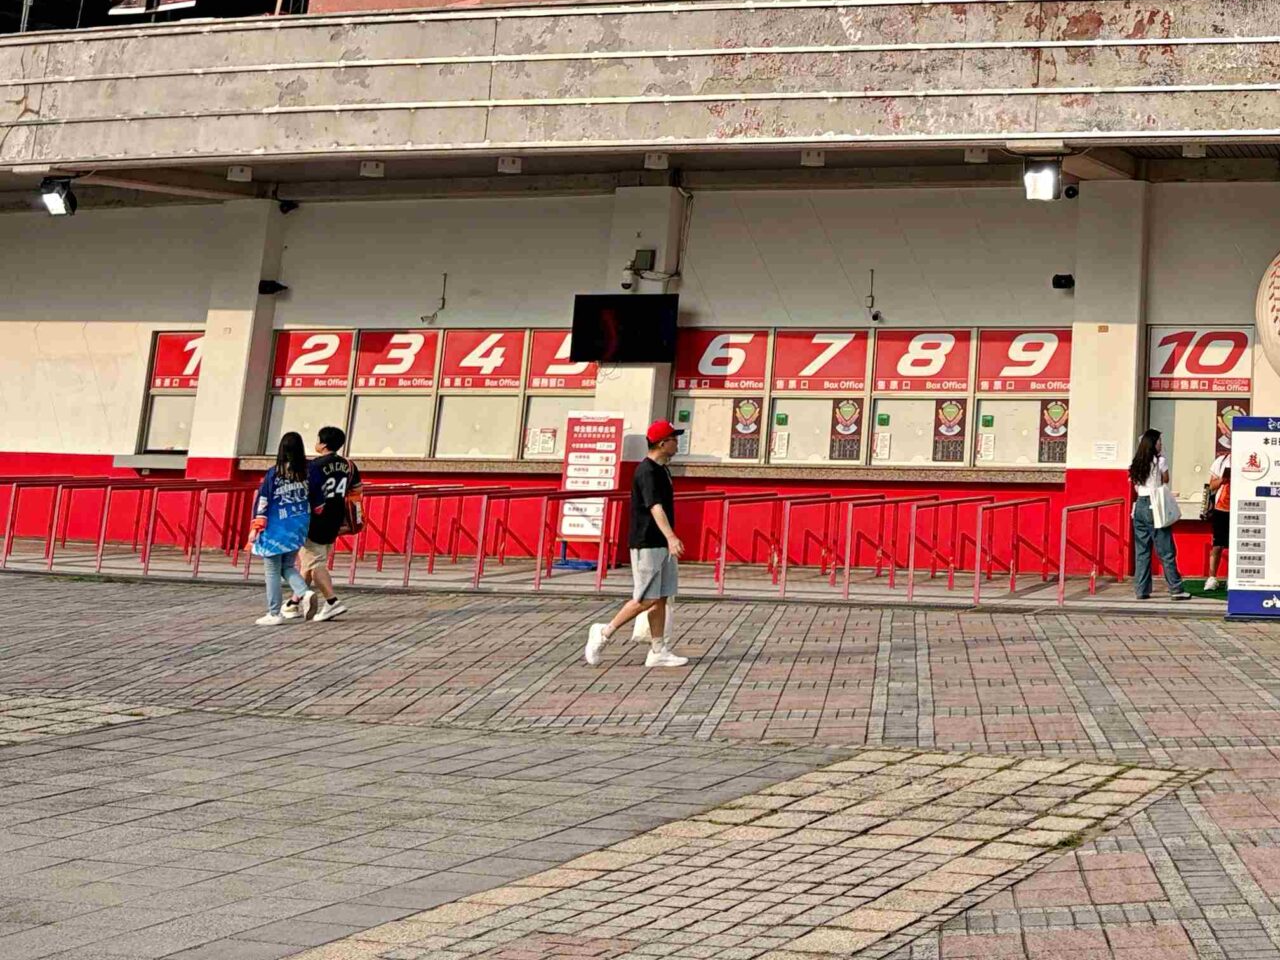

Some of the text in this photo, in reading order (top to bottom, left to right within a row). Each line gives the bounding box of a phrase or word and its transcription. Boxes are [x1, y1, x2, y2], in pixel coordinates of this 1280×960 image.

[182, 335, 203, 375] 1
[288, 333, 340, 375] 2
[372, 333, 424, 375] 3
[459, 333, 506, 375] 4
[698, 333, 754, 377] 6
[797, 333, 855, 377] 7
[896, 333, 956, 377] 8
[999, 333, 1059, 377] 9
[1157, 331, 1249, 375] 10
[314, 377, 348, 386] Box Office
[398, 378, 433, 386] Box Office
[485, 378, 520, 386] Box Office
[724, 380, 763, 388] Box Office
[824, 380, 864, 389] Box Office
[926, 380, 966, 390] Box Office
[1030, 380, 1046, 390] Box
[321, 477, 348, 499] 24
